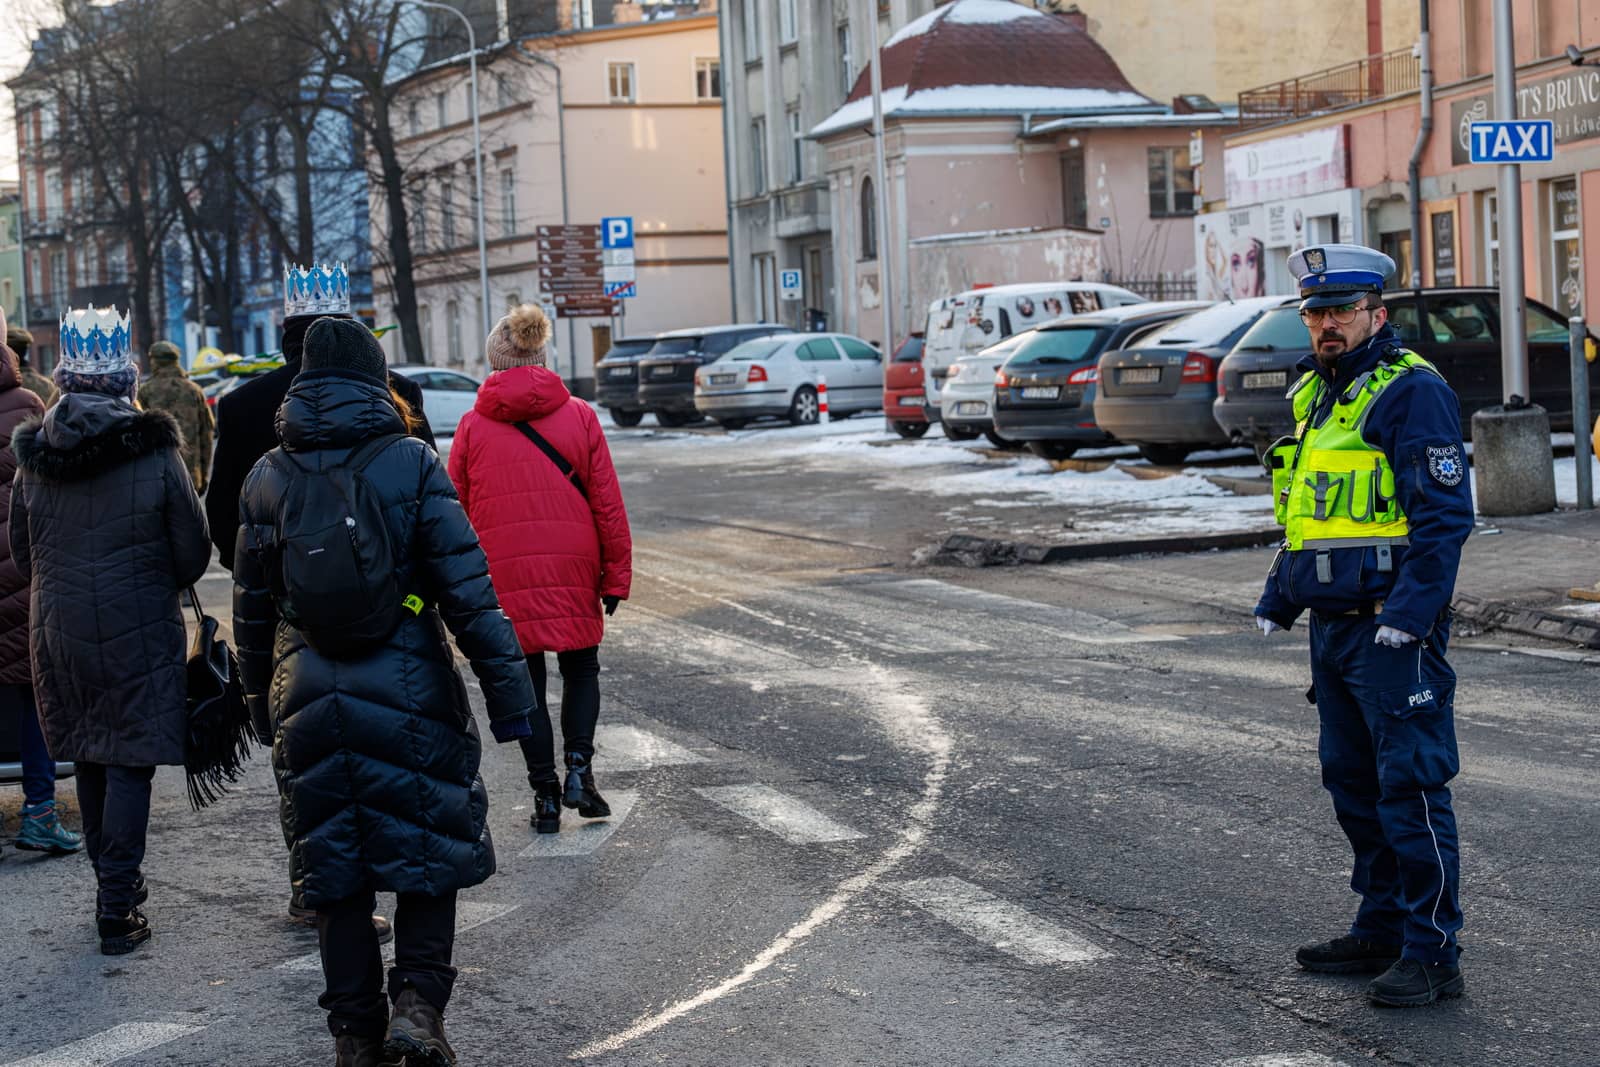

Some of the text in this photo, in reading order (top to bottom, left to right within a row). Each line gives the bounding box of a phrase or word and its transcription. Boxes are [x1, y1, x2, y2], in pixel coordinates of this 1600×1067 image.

[1517, 84, 1541, 118] T'S
[1472, 125, 1548, 158] TAXI
[608, 219, 629, 247] P
[786, 273, 797, 287] P
[1428, 445, 1458, 456] POLICJA
